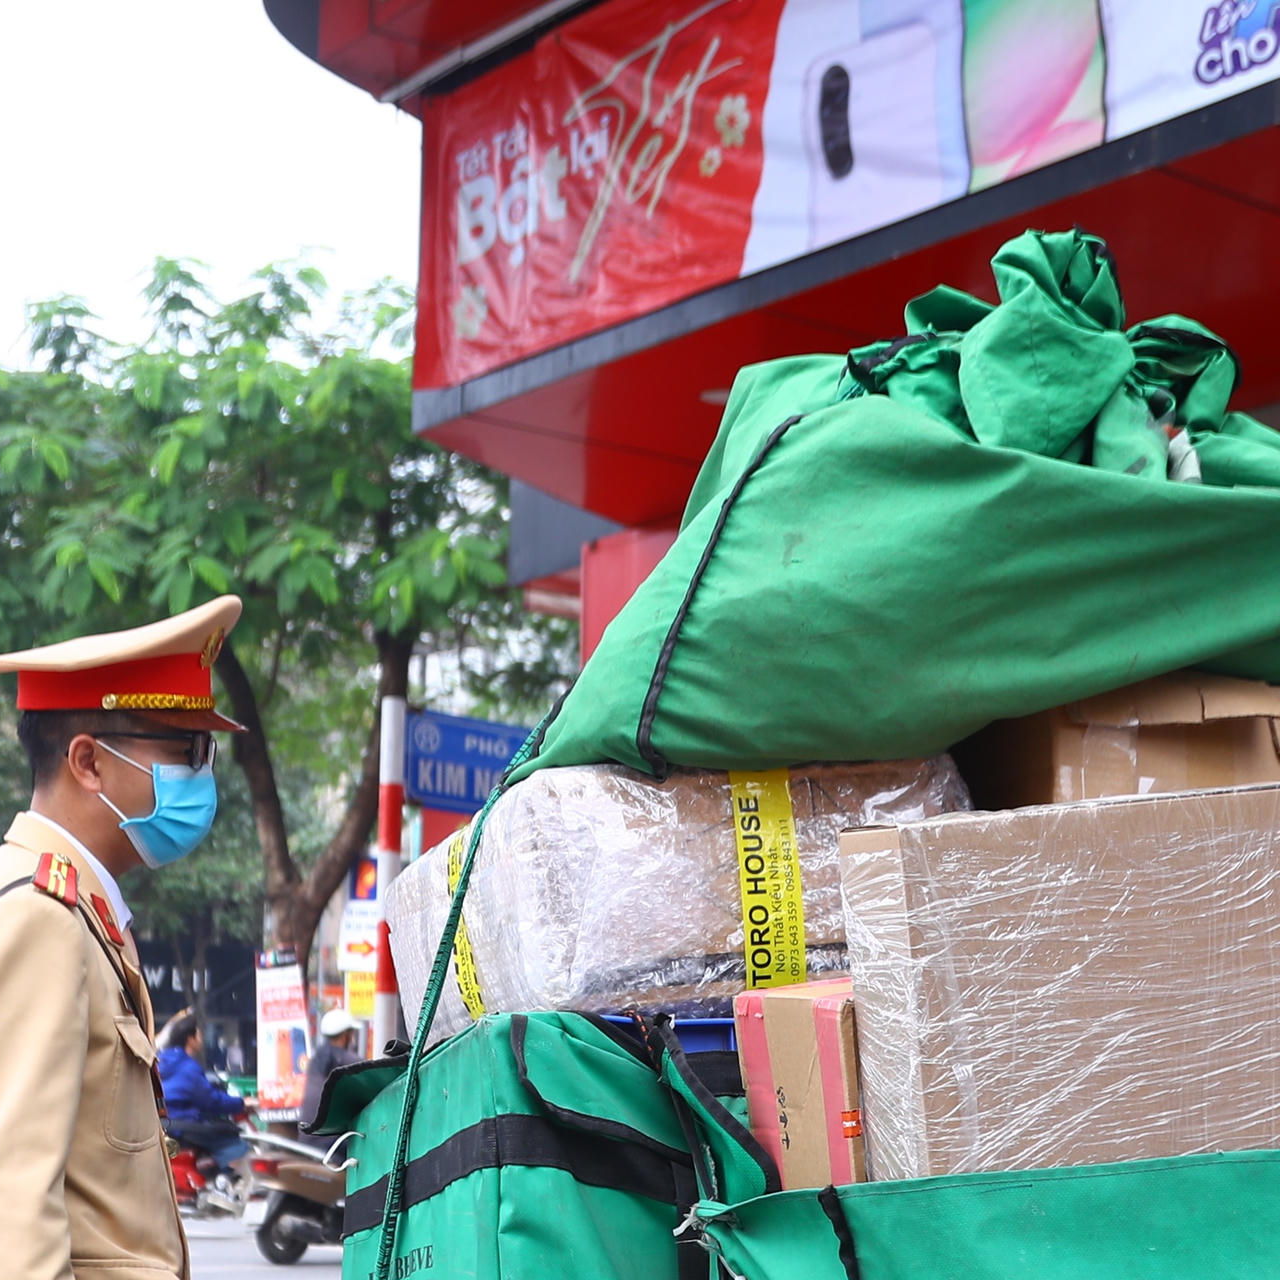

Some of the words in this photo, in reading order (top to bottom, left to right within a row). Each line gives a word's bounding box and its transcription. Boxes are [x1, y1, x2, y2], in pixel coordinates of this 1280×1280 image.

[1195, 29, 1278, 85] cho
[570, 112, 610, 179] lại
[418, 758, 466, 798] KIM
[738, 795, 767, 895] HOUSE
[787, 902, 797, 924] 359
[772, 915, 784, 946] Thất
[788, 924, 799, 946] 643
[774, 950, 786, 973] Nội
[790, 947, 800, 976] 0973
